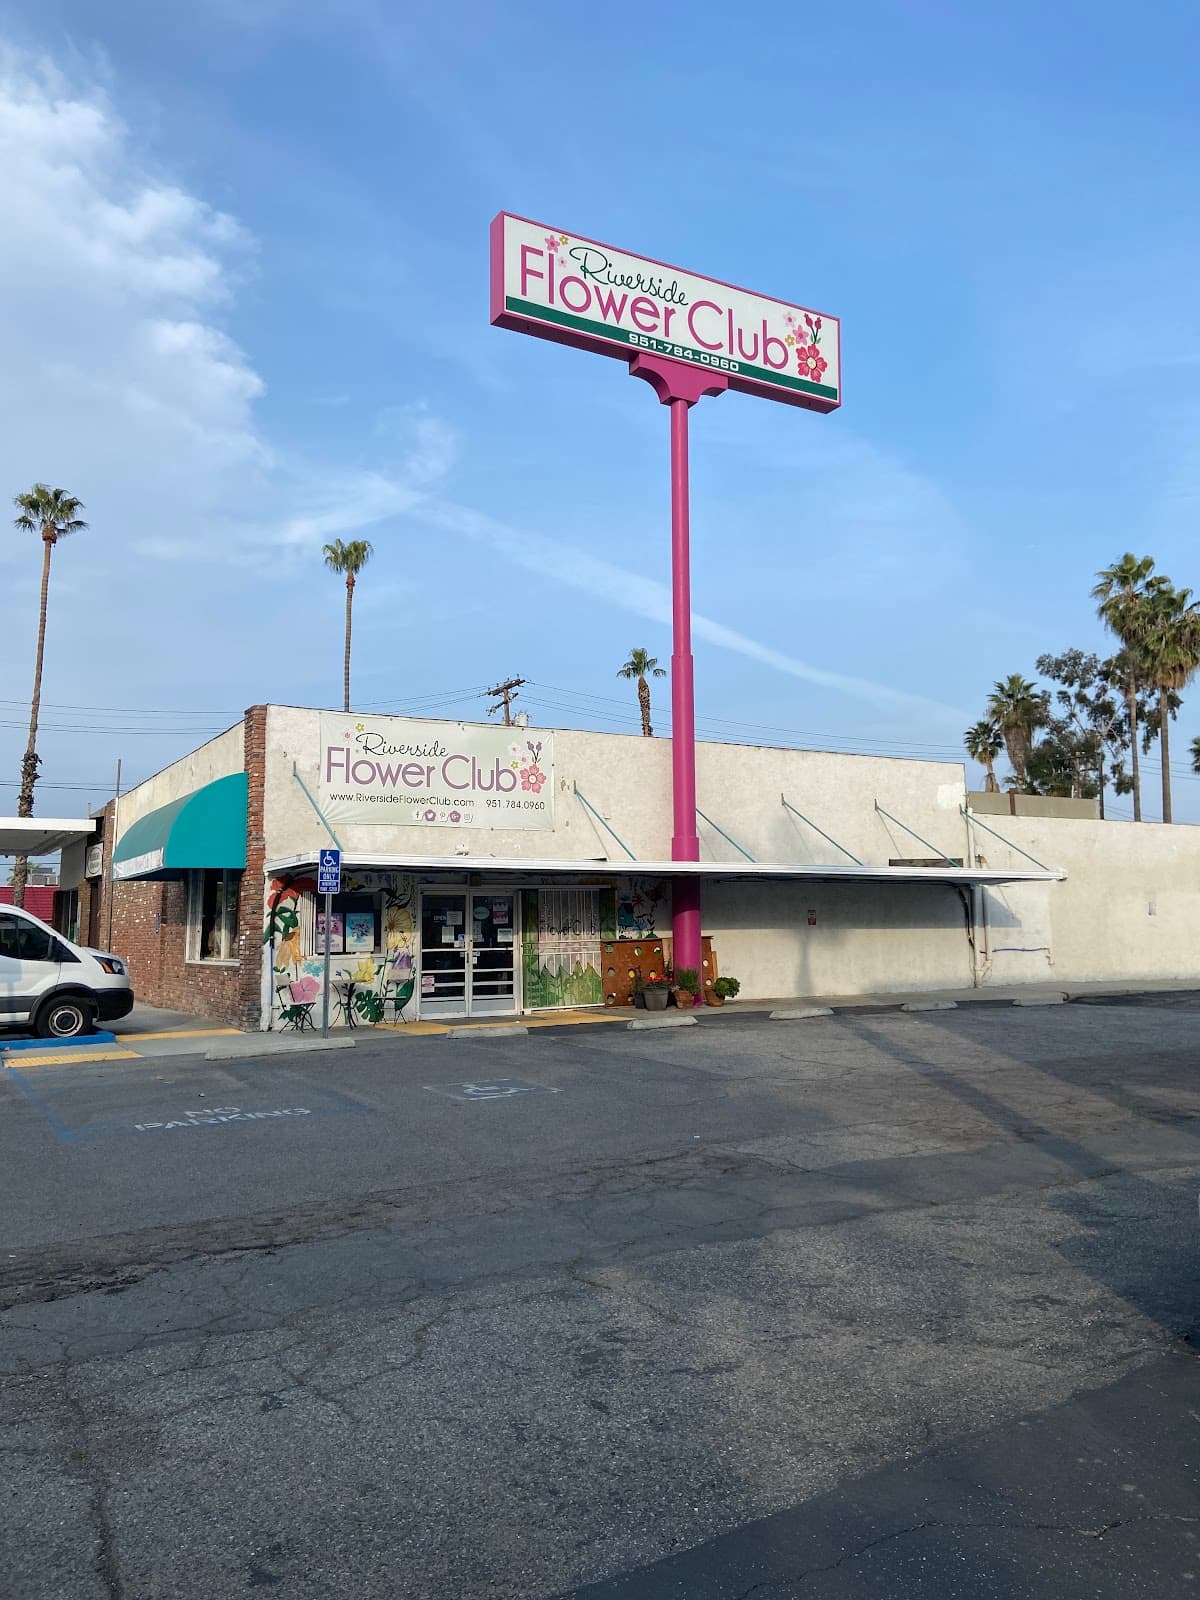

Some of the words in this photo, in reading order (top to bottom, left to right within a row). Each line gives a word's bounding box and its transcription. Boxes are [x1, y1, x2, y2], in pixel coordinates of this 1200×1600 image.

[569, 246, 689, 306] Riverside
[520, 244, 676, 338] Flower
[687, 300, 789, 370] Club
[628, 333, 740, 372] 951-784-0960
[355, 732, 449, 758] Riverside
[326, 746, 436, 788] Flower
[441, 754, 517, 793] Club
[329, 792, 475, 808] www.RiversideFlowerClub.com
[485, 799, 546, 811] 951.784.0960
[134, 1108, 312, 1131] PARKING
[184, 1106, 241, 1118] NO
